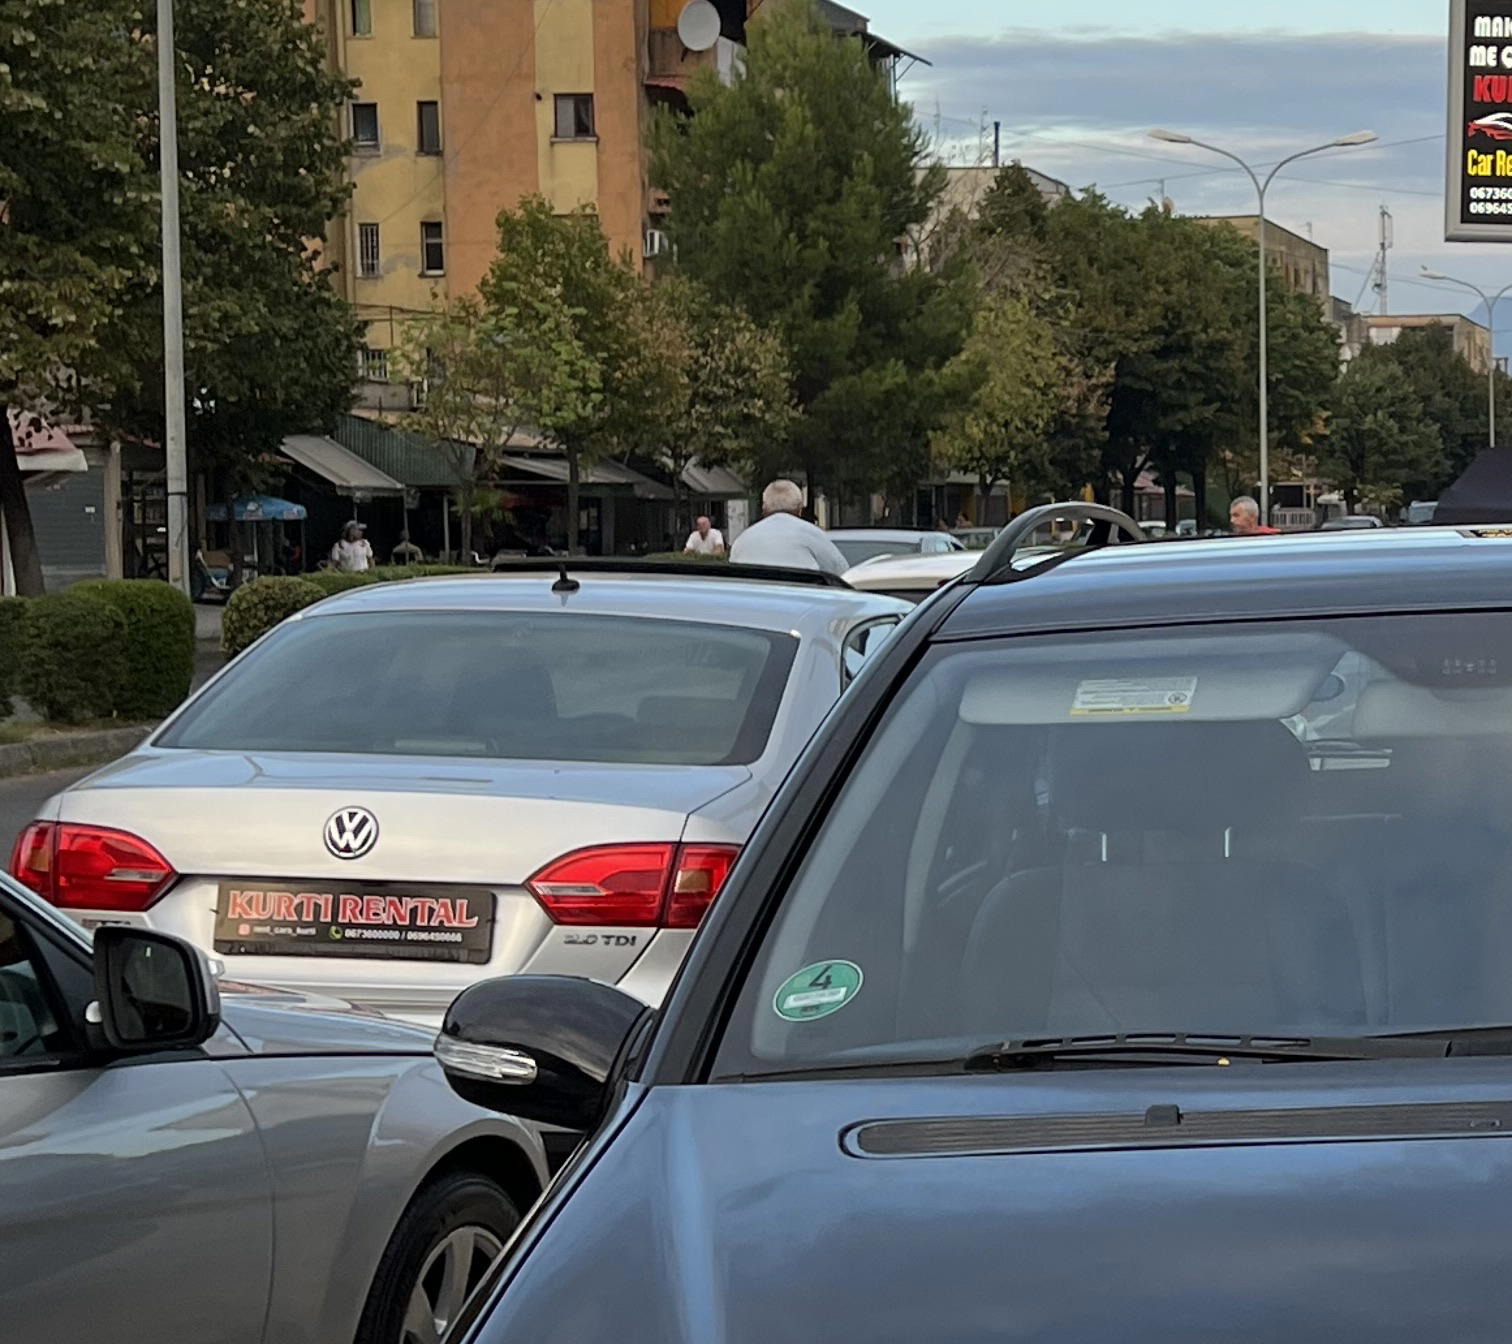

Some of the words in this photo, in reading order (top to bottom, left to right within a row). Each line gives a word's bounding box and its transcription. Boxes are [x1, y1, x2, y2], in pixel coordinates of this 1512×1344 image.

[1469, 45, 1498, 67] ME
[1467, 149, 1493, 176] Car
[228, 890, 333, 922] KURTI
[338, 894, 478, 927] RENTAL
[601, 935, 636, 946] TDI
